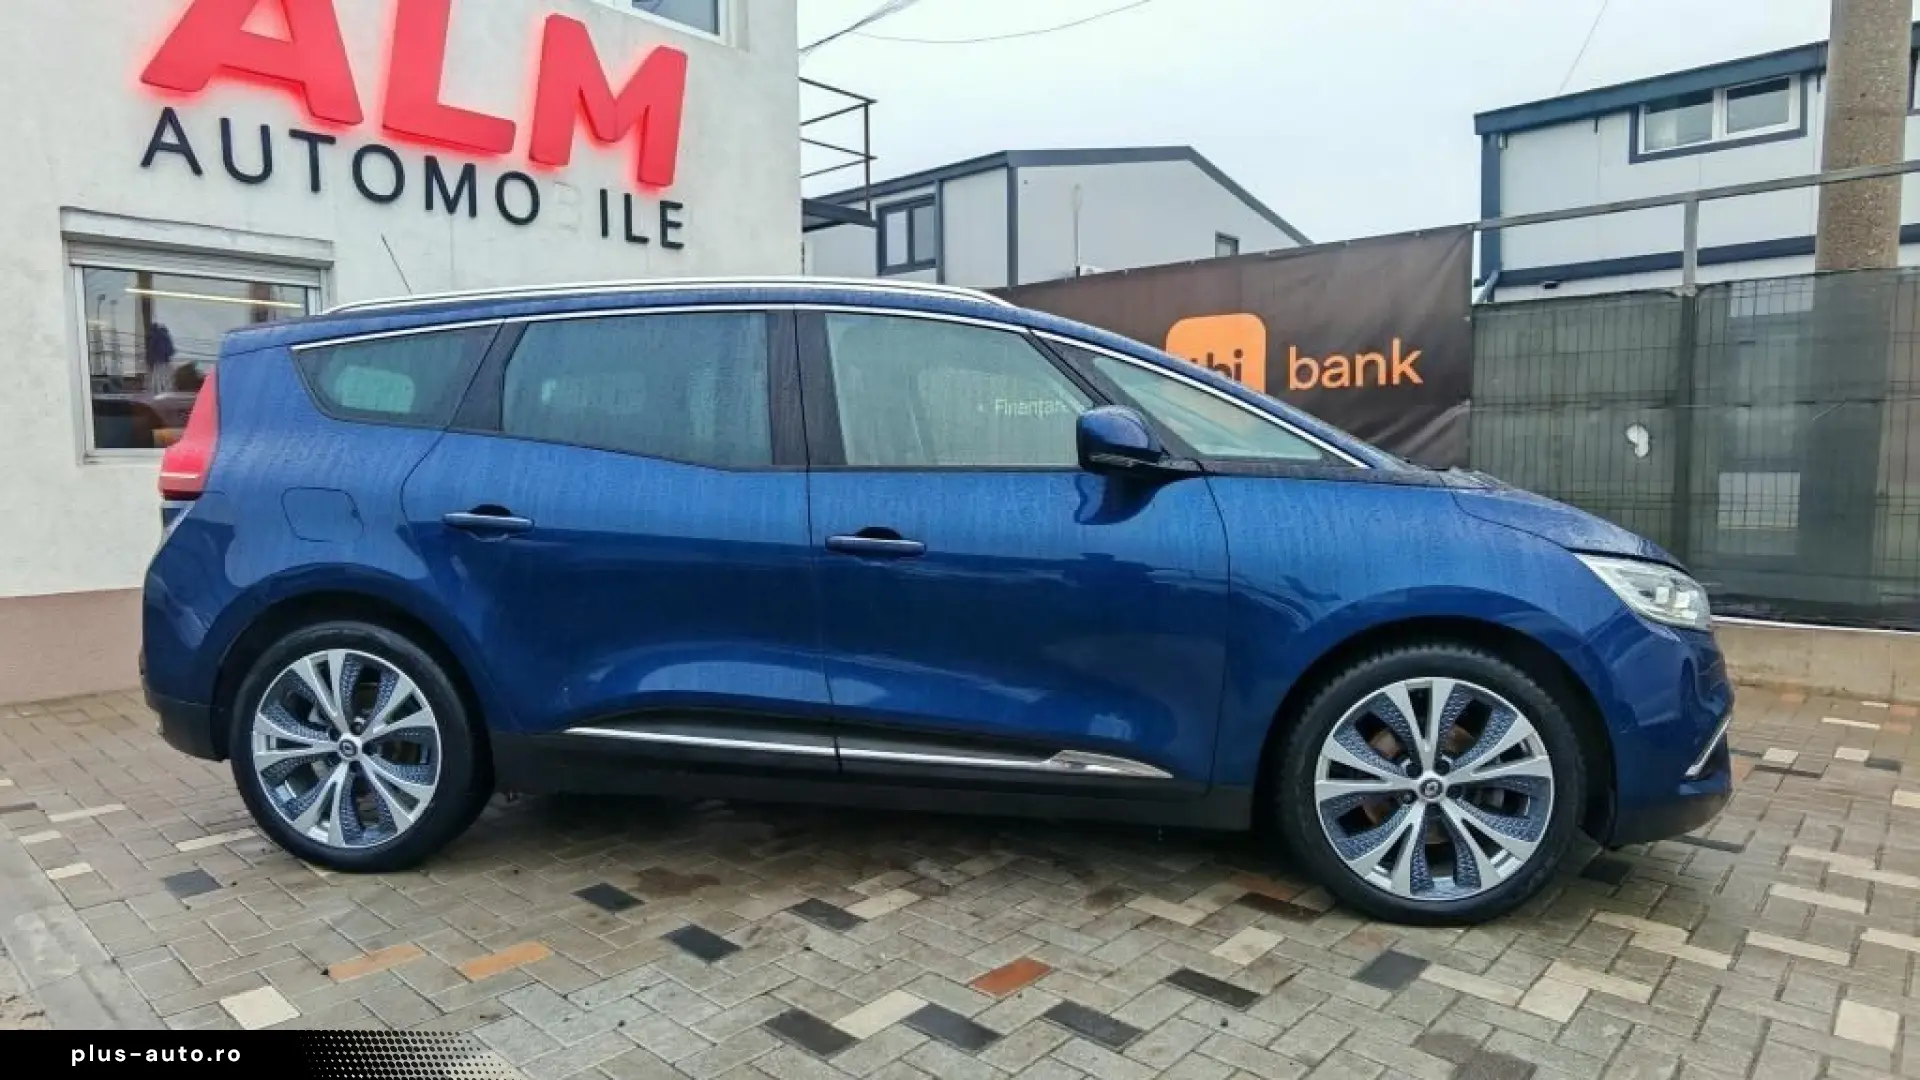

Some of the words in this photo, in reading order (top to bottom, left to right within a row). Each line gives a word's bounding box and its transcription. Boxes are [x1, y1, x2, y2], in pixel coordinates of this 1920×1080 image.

[141, 0, 689, 188] ALM
[141, 106, 685, 250] AUTOMOILE
[1289, 337, 1424, 390] bank
